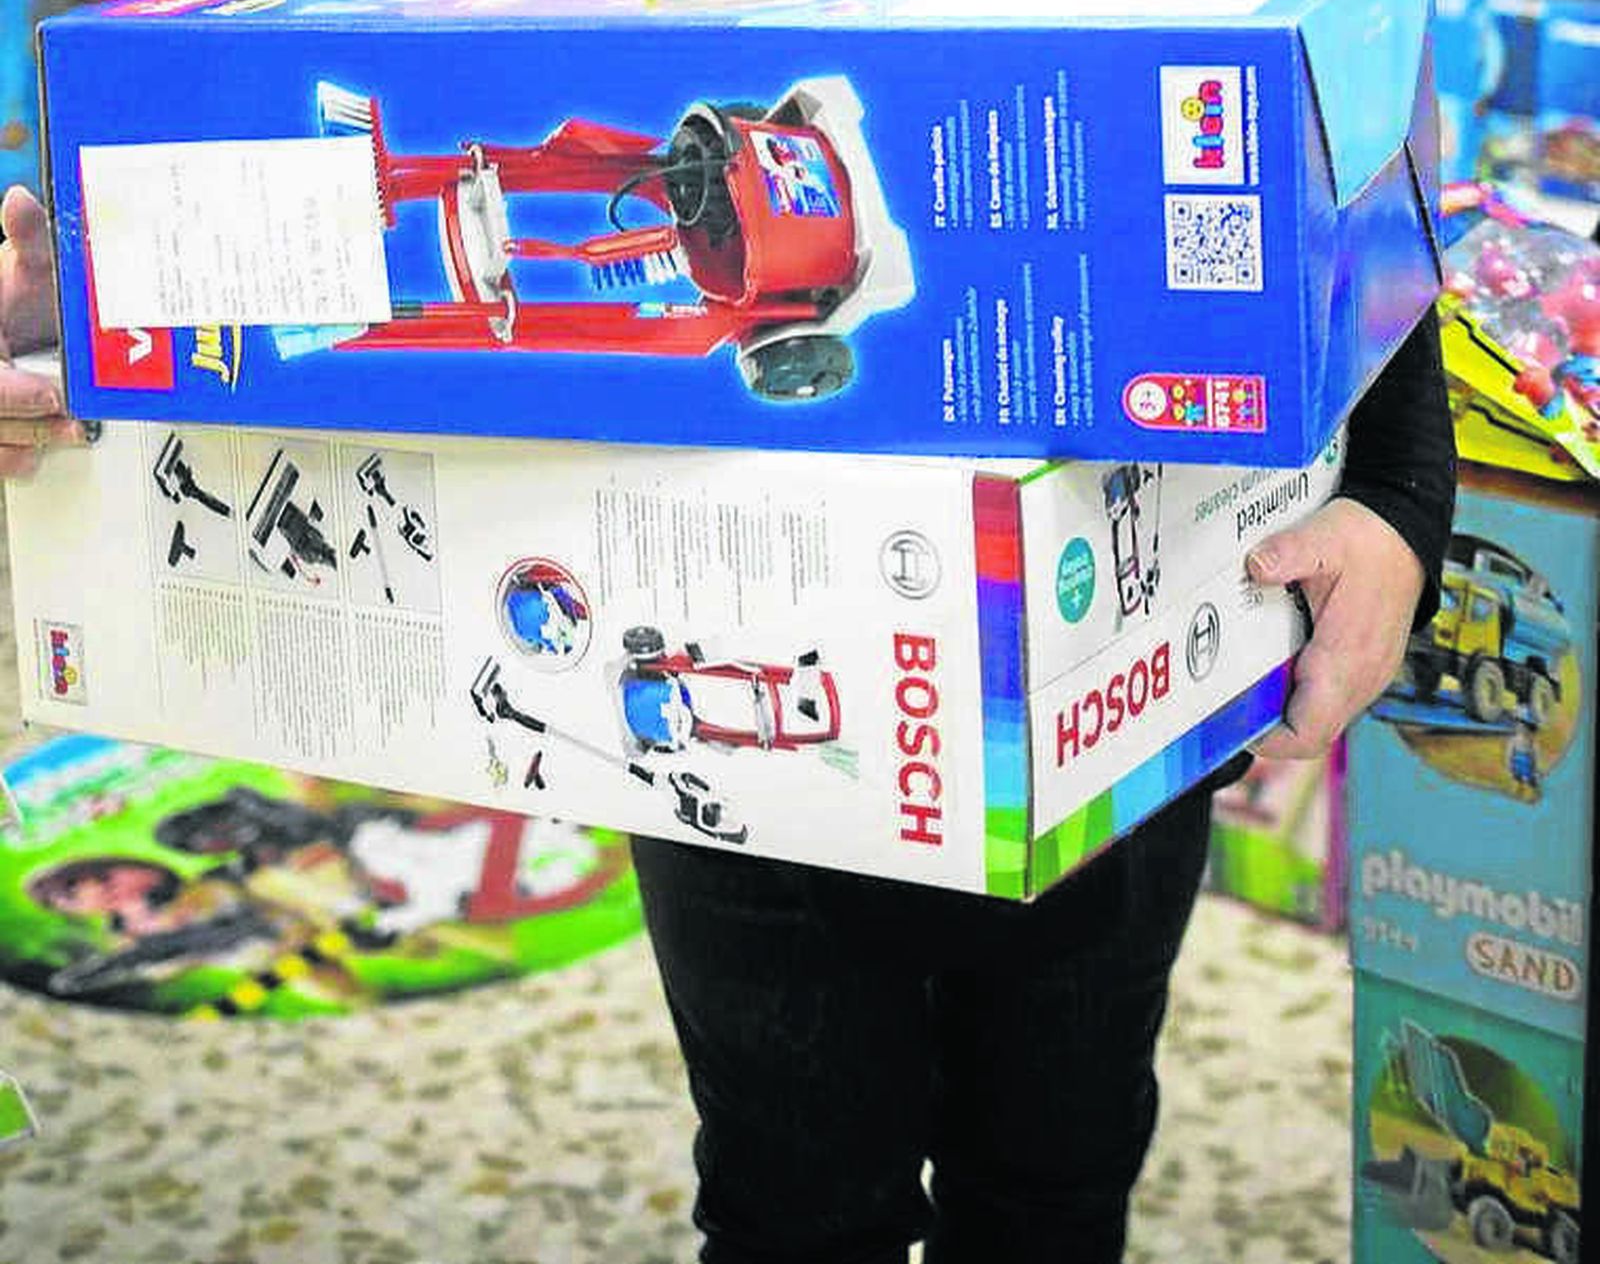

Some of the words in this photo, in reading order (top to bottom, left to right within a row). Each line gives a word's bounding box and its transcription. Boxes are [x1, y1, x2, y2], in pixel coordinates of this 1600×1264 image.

[1184, 80, 1224, 168] klein
[1235, 473, 1310, 543] Unlimited
[893, 632, 943, 846] BOSCH
[1057, 641, 1171, 768] BOSCH
[1362, 849, 1584, 946] playmobil
[1474, 937, 1576, 993] SAND
